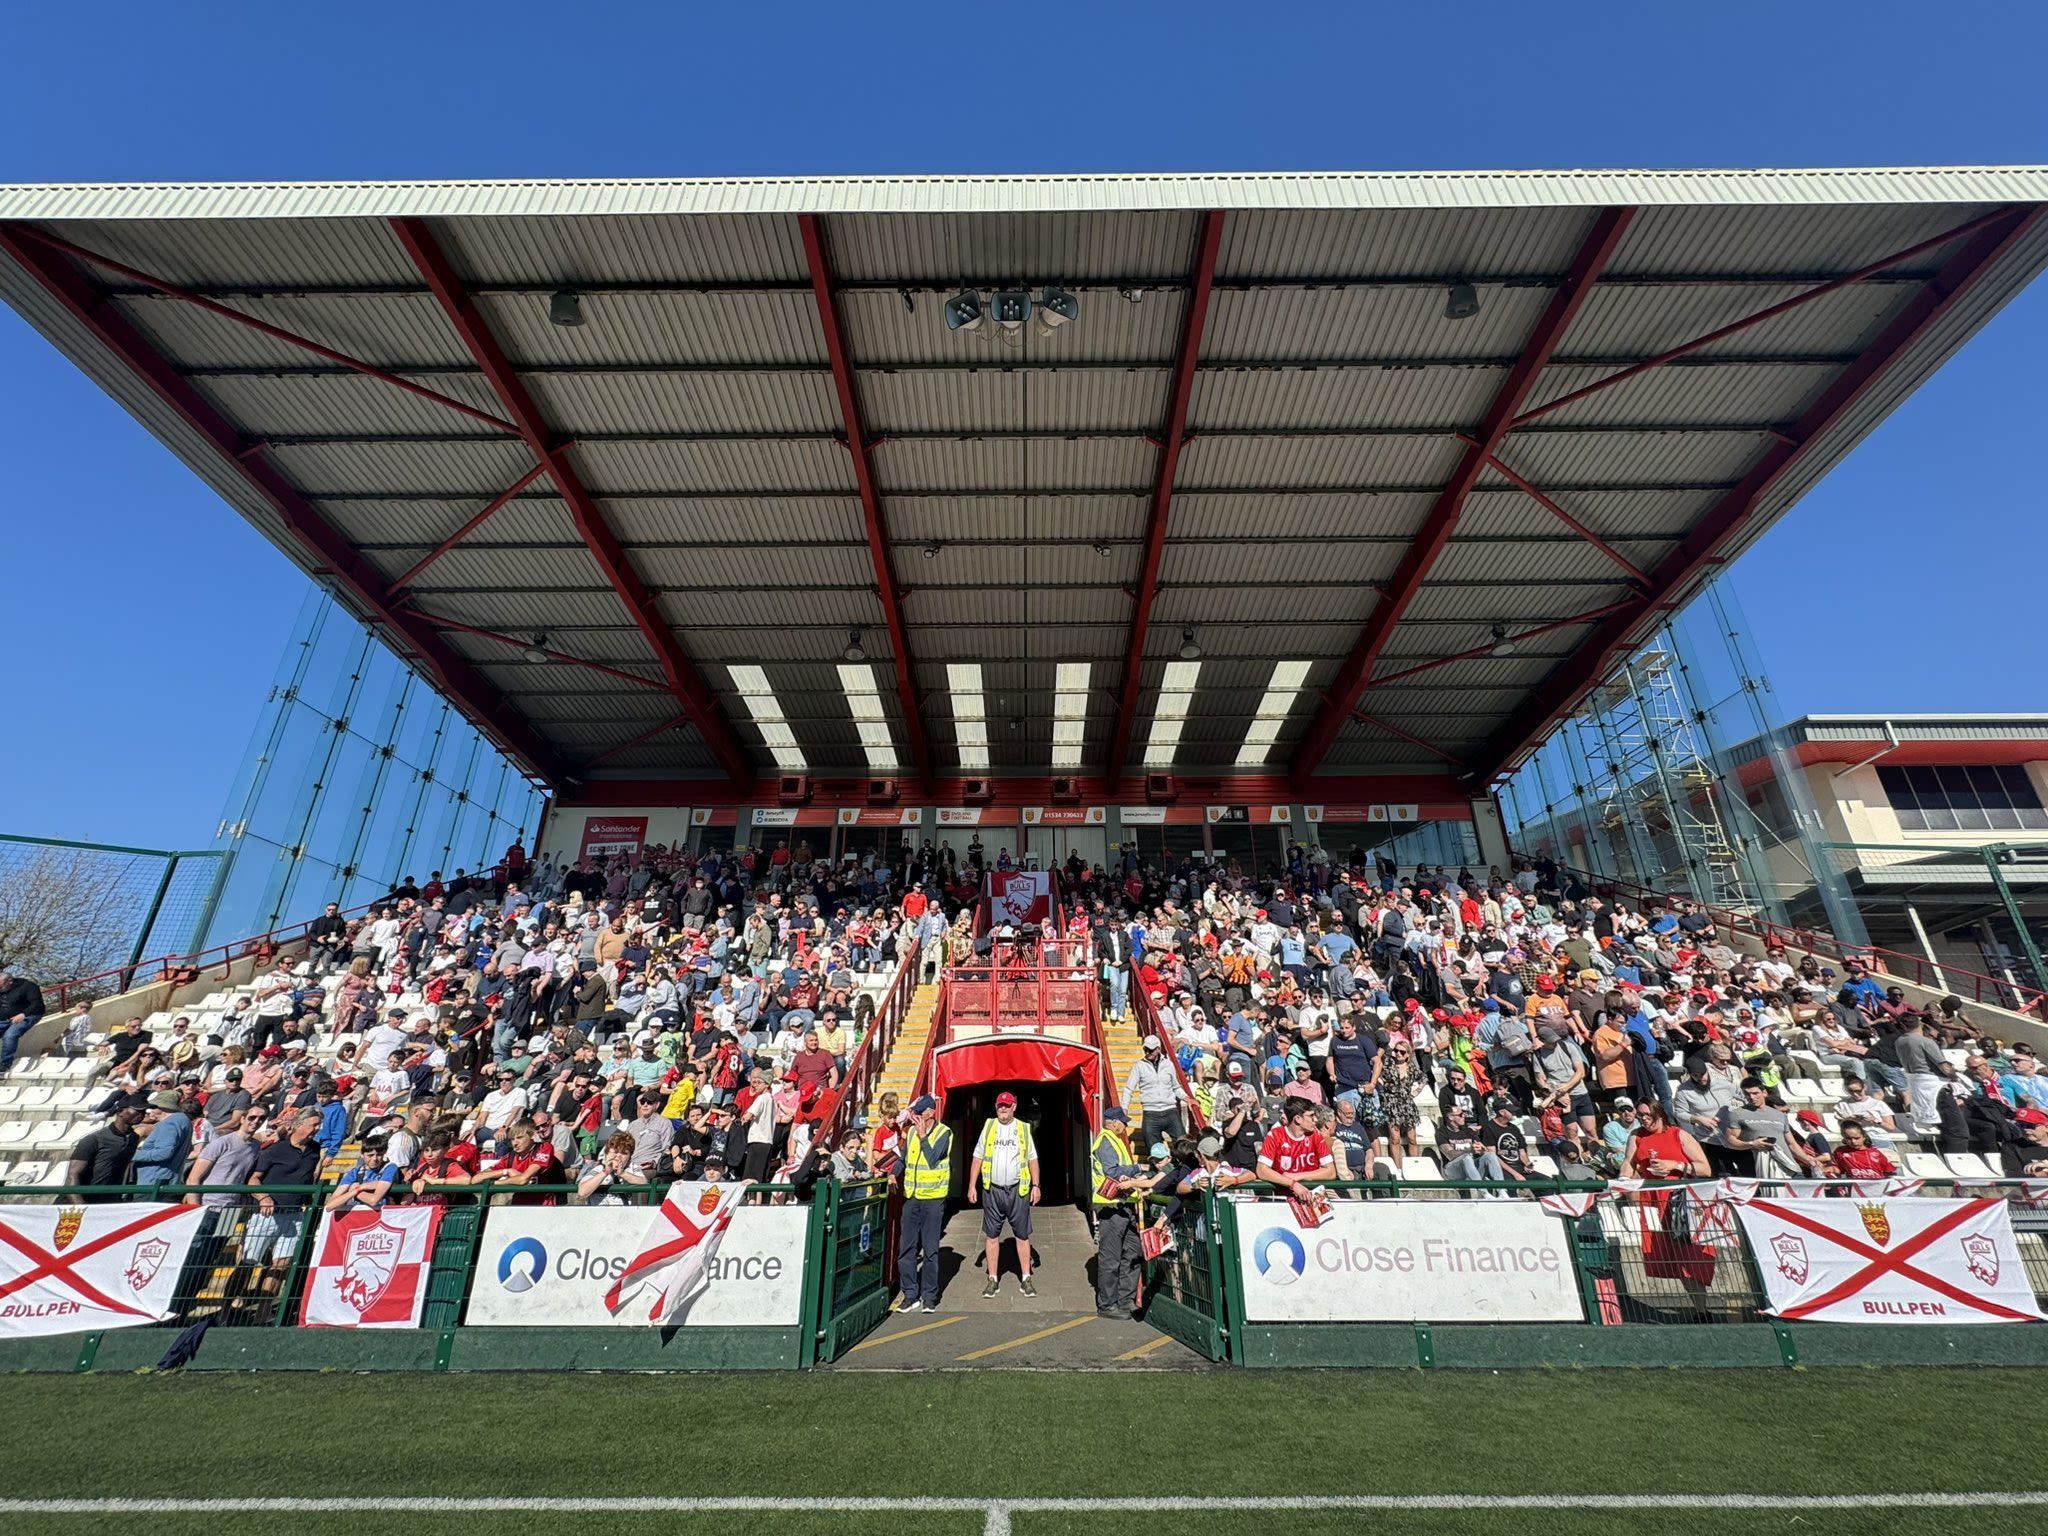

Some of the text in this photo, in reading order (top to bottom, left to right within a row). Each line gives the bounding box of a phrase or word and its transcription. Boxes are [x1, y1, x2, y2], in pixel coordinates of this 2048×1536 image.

[729, 1055, 739, 1070] 8
[1292, 1152, 1315, 1172] JTC
[357, 1239, 394, 1251] BULLS
[1315, 1238, 1560, 1273] Close Finance
[556, 1248, 782, 1281] Clos ance
[0, 1301, 81, 1318] BULLPEN
[1862, 1301, 1947, 1316] BULLPEN
